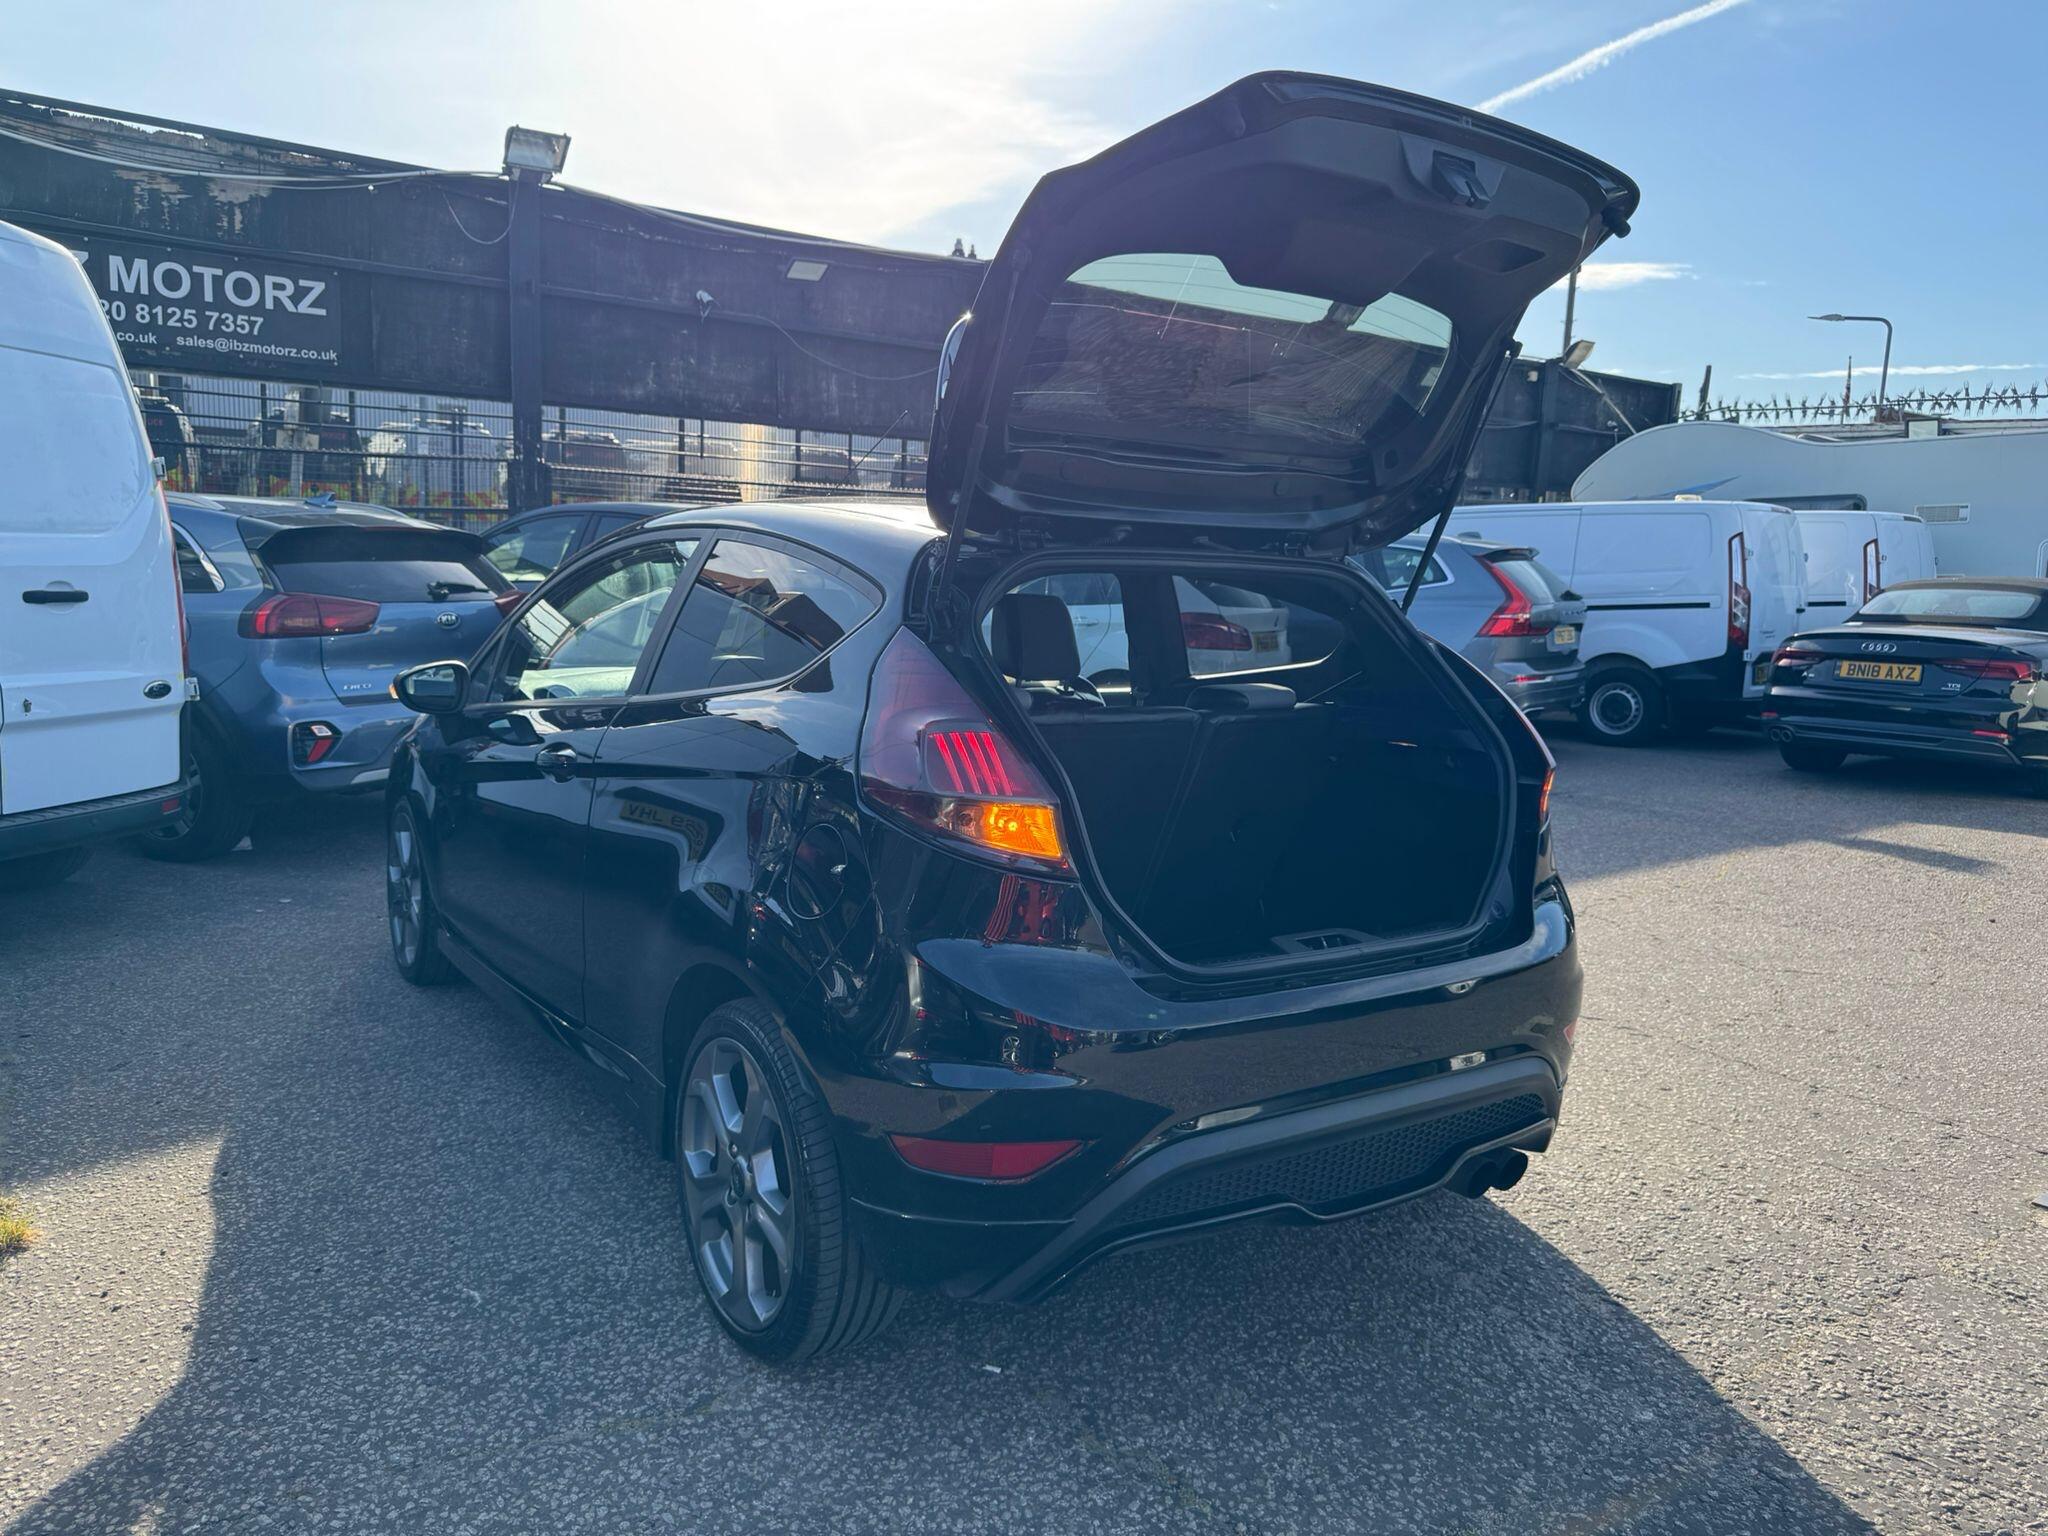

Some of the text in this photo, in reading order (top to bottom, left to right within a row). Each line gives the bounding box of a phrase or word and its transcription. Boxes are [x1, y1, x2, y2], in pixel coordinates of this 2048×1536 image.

[108, 254, 327, 316] MOTORZ
[135, 306, 198, 330] 8125
[205, 311, 264, 336] 7357
[176, 335, 338, 361] sales@ibzmotorz.co.uk
[1846, 663, 1917, 681] BN18 AXZ
